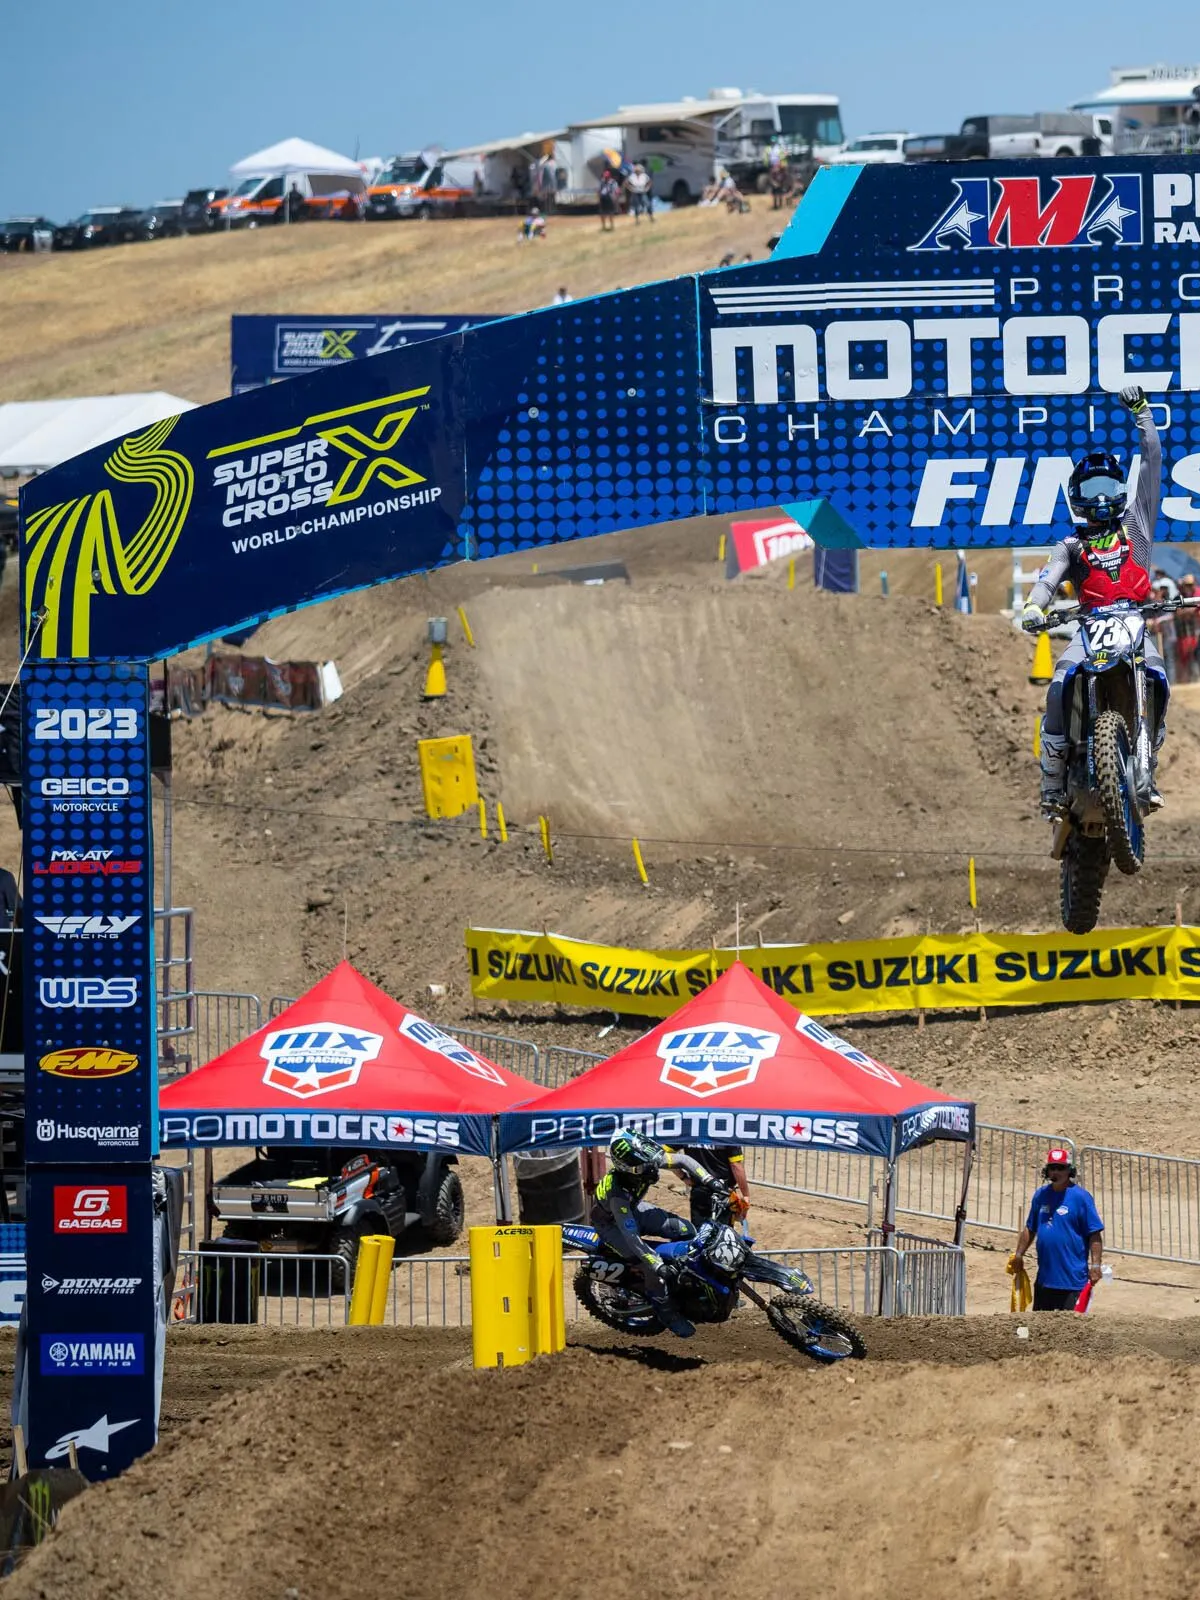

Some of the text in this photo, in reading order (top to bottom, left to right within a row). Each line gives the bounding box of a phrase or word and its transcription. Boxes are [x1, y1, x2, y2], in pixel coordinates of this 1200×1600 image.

[907, 173, 1143, 251] AMA
[213, 438, 329, 487] SUPER
[226, 460, 328, 505] MOTO
[222, 480, 334, 528] CROSS
[232, 487, 442, 554] WORLD CHAMPIONSHIP
[35, 708, 138, 740] 2023
[41, 777, 130, 795] GEICO
[53, 803, 119, 812] MOTORCYCLE
[33, 860, 141, 876] LEGENDS
[34, 916, 142, 933] FLY
[488, 949, 577, 985] SUZUKI
[583, 961, 680, 996] SUZUKI
[686, 963, 814, 998] SKI
[828, 954, 977, 992] SUZUKI
[995, 945, 1167, 982] SUZUKI
[40, 977, 139, 1008] WPS
[269, 1031, 377, 1052] MX
[666, 1031, 775, 1051] MX
[40, 1051, 138, 1071] FMF
[278, 1055, 353, 1065] PRO RACING
[675, 1054, 750, 1063] PRO RACING
[57, 1124, 139, 1140] Husqvarna
[160, 1112, 461, 1147] ROMOTOCROSS
[58, 1218, 123, 1229] GASGAS
[589, 1260, 625, 1283] 32
[61, 1277, 143, 1288] DUNLOP
[69, 1342, 136, 1361] YAMAHA
